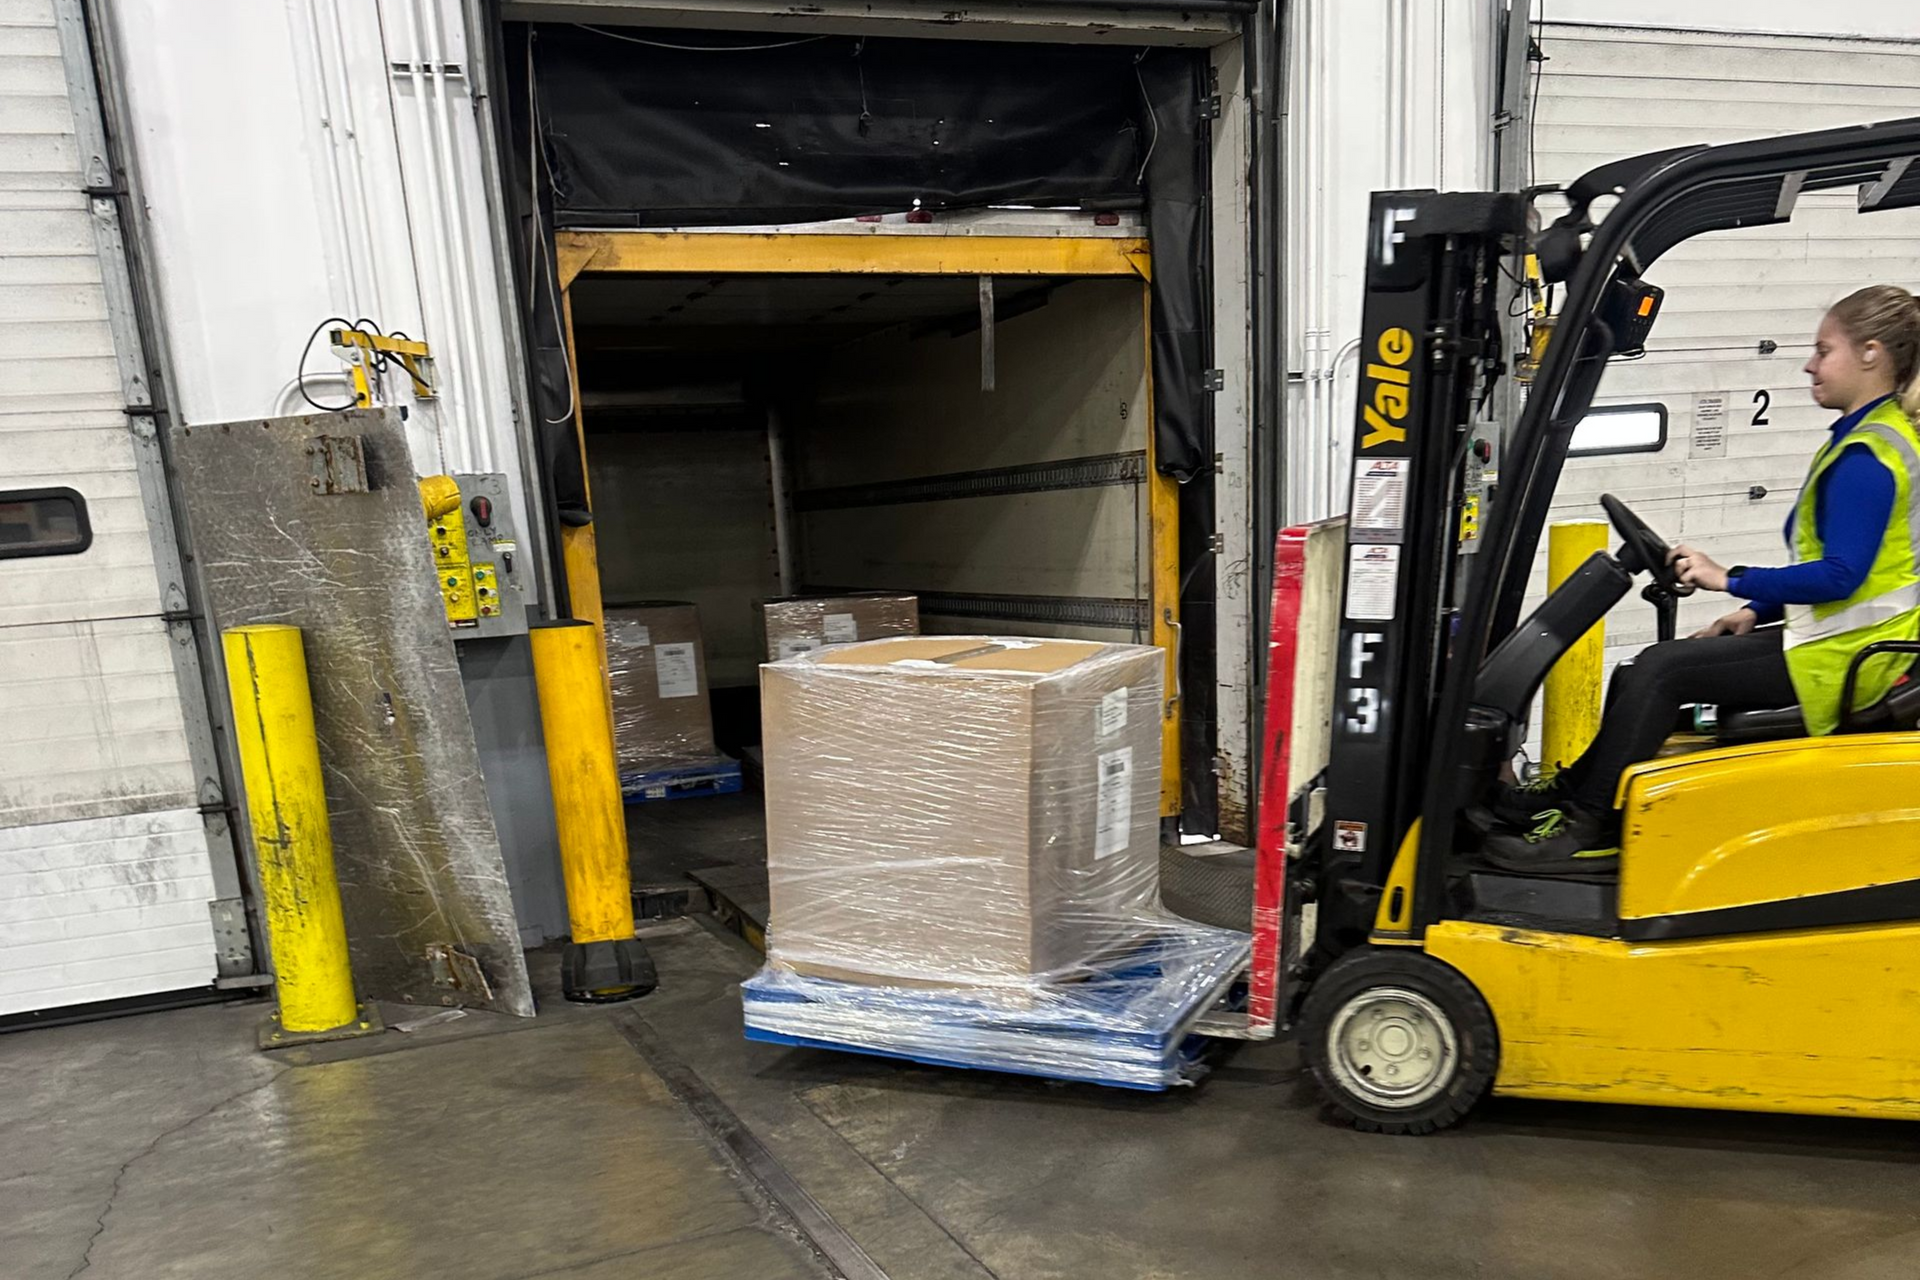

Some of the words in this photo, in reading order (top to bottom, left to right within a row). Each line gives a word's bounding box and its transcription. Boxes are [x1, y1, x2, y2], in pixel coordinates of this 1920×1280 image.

[1381, 208, 1417, 266] F
[1361, 326, 1414, 450] Yale
[1750, 389, 1771, 427] 2
